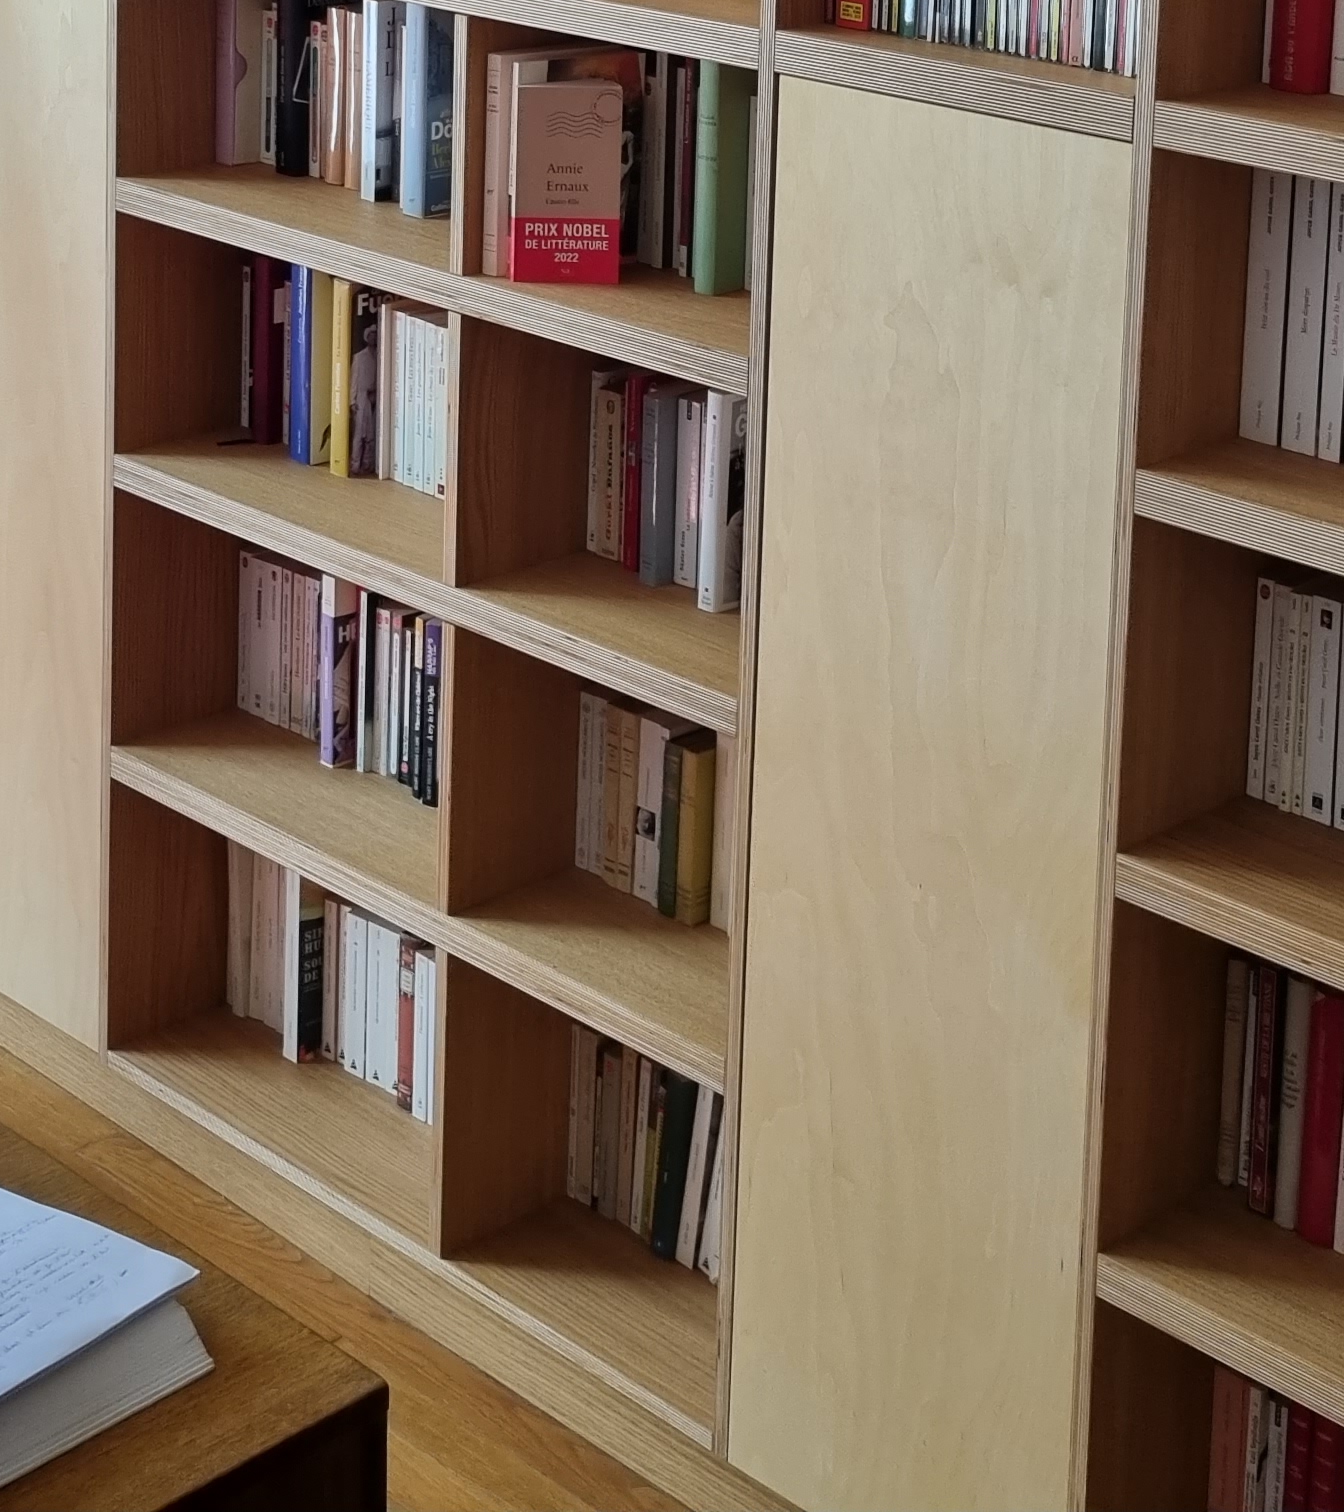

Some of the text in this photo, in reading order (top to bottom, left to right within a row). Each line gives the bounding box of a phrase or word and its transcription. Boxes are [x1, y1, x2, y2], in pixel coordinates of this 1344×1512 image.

[546, 162, 584, 174] Annie
[546, 180, 589, 192] Ernaux
[525, 223, 609, 237] PRIX NOBEL
[525, 237, 609, 250] DE LITTÉRATURE
[554, 252, 579, 262] 2022
